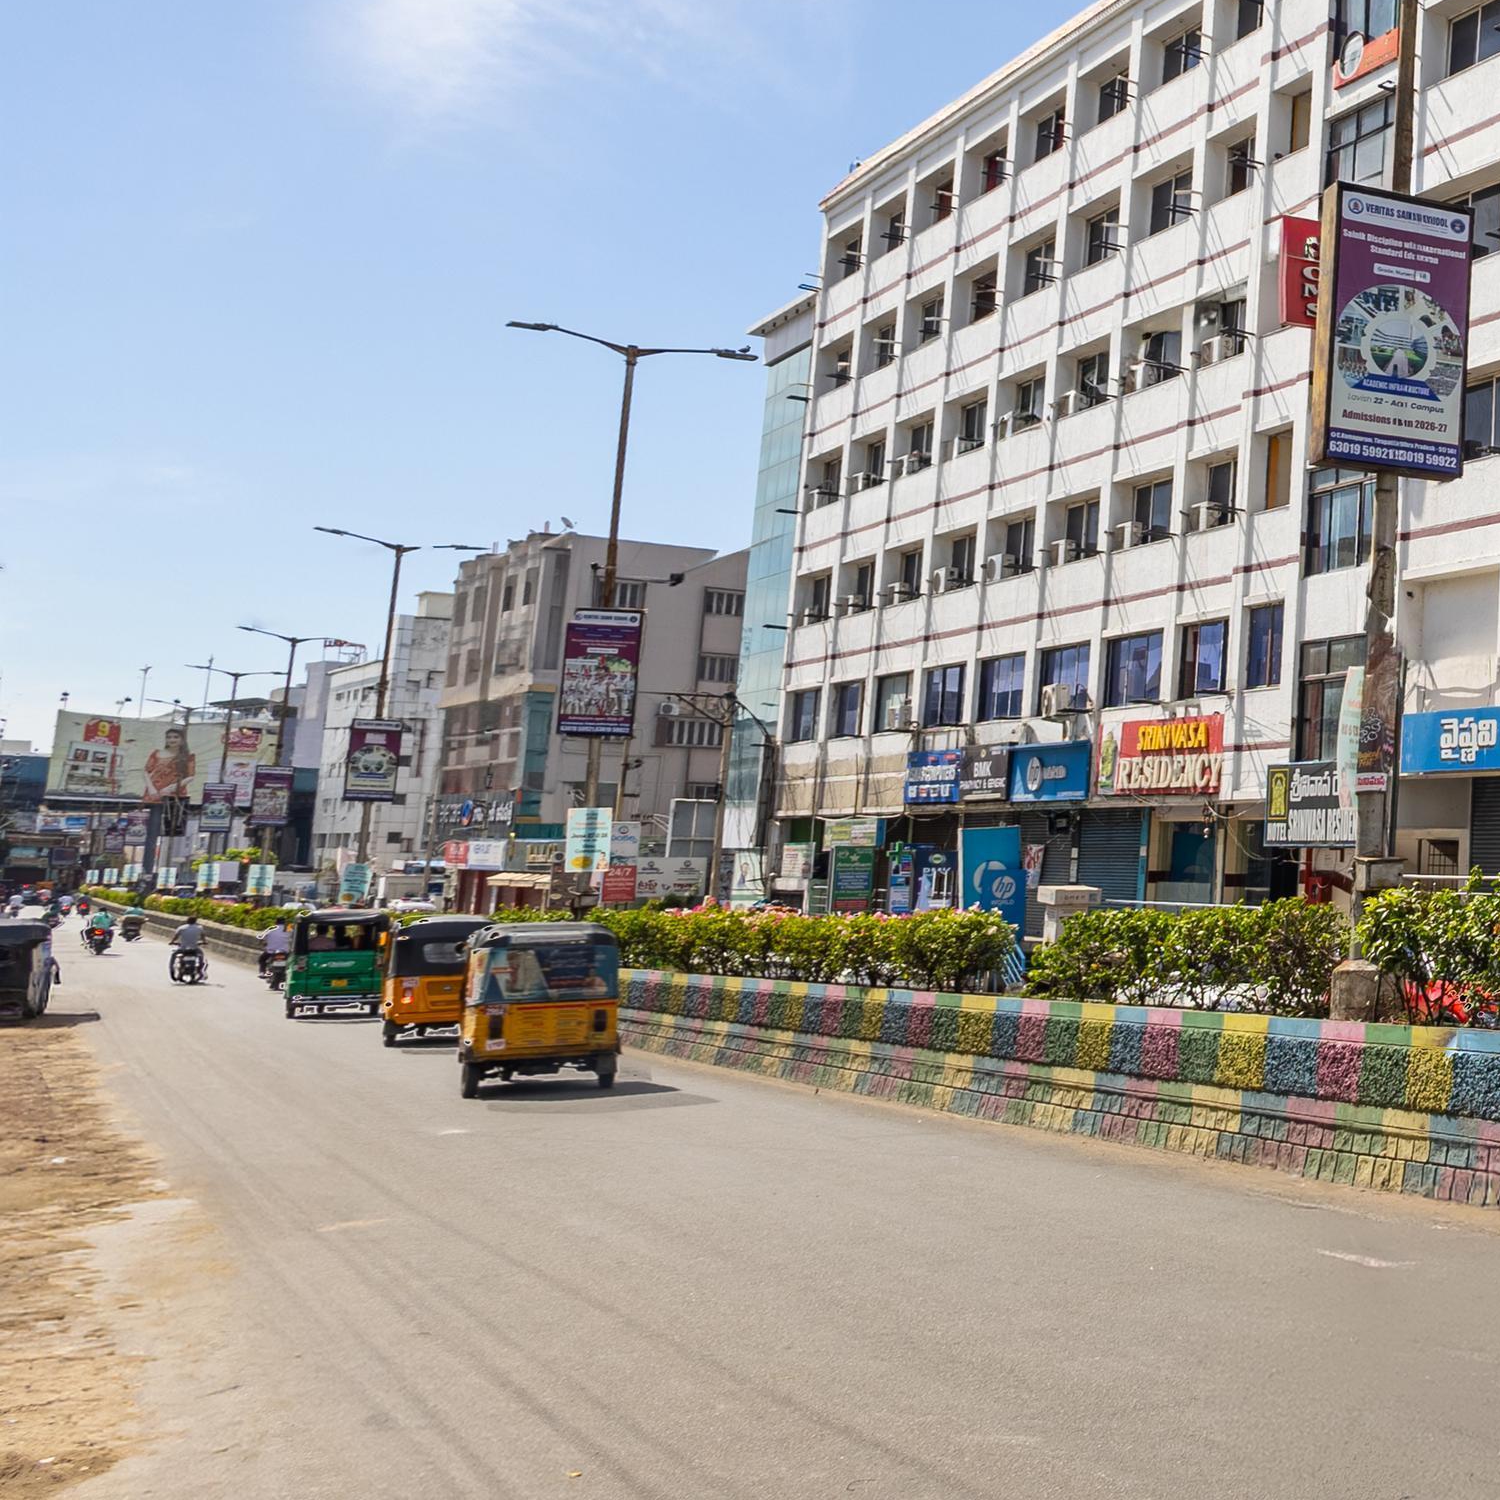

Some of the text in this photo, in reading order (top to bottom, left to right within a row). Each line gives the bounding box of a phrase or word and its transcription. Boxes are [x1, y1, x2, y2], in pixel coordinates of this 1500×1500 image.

[1365, 203, 1395, 217] VERITAS
[1373, 397, 1384, 405] 22
[1411, 403, 1444, 414] Campus
[1342, 409, 1391, 425] Admissions
[1329, 440, 1360, 455] 63019
[1426, 454, 1457, 468] 59922
[1137, 722, 1208, 751] SRINIVASA
[973, 761, 992, 778] BMK
[1117, 753, 1223, 790] RESIDENCY
[1267, 822, 1287, 841] HOTEL
[608, 867, 632, 877] 24/7
